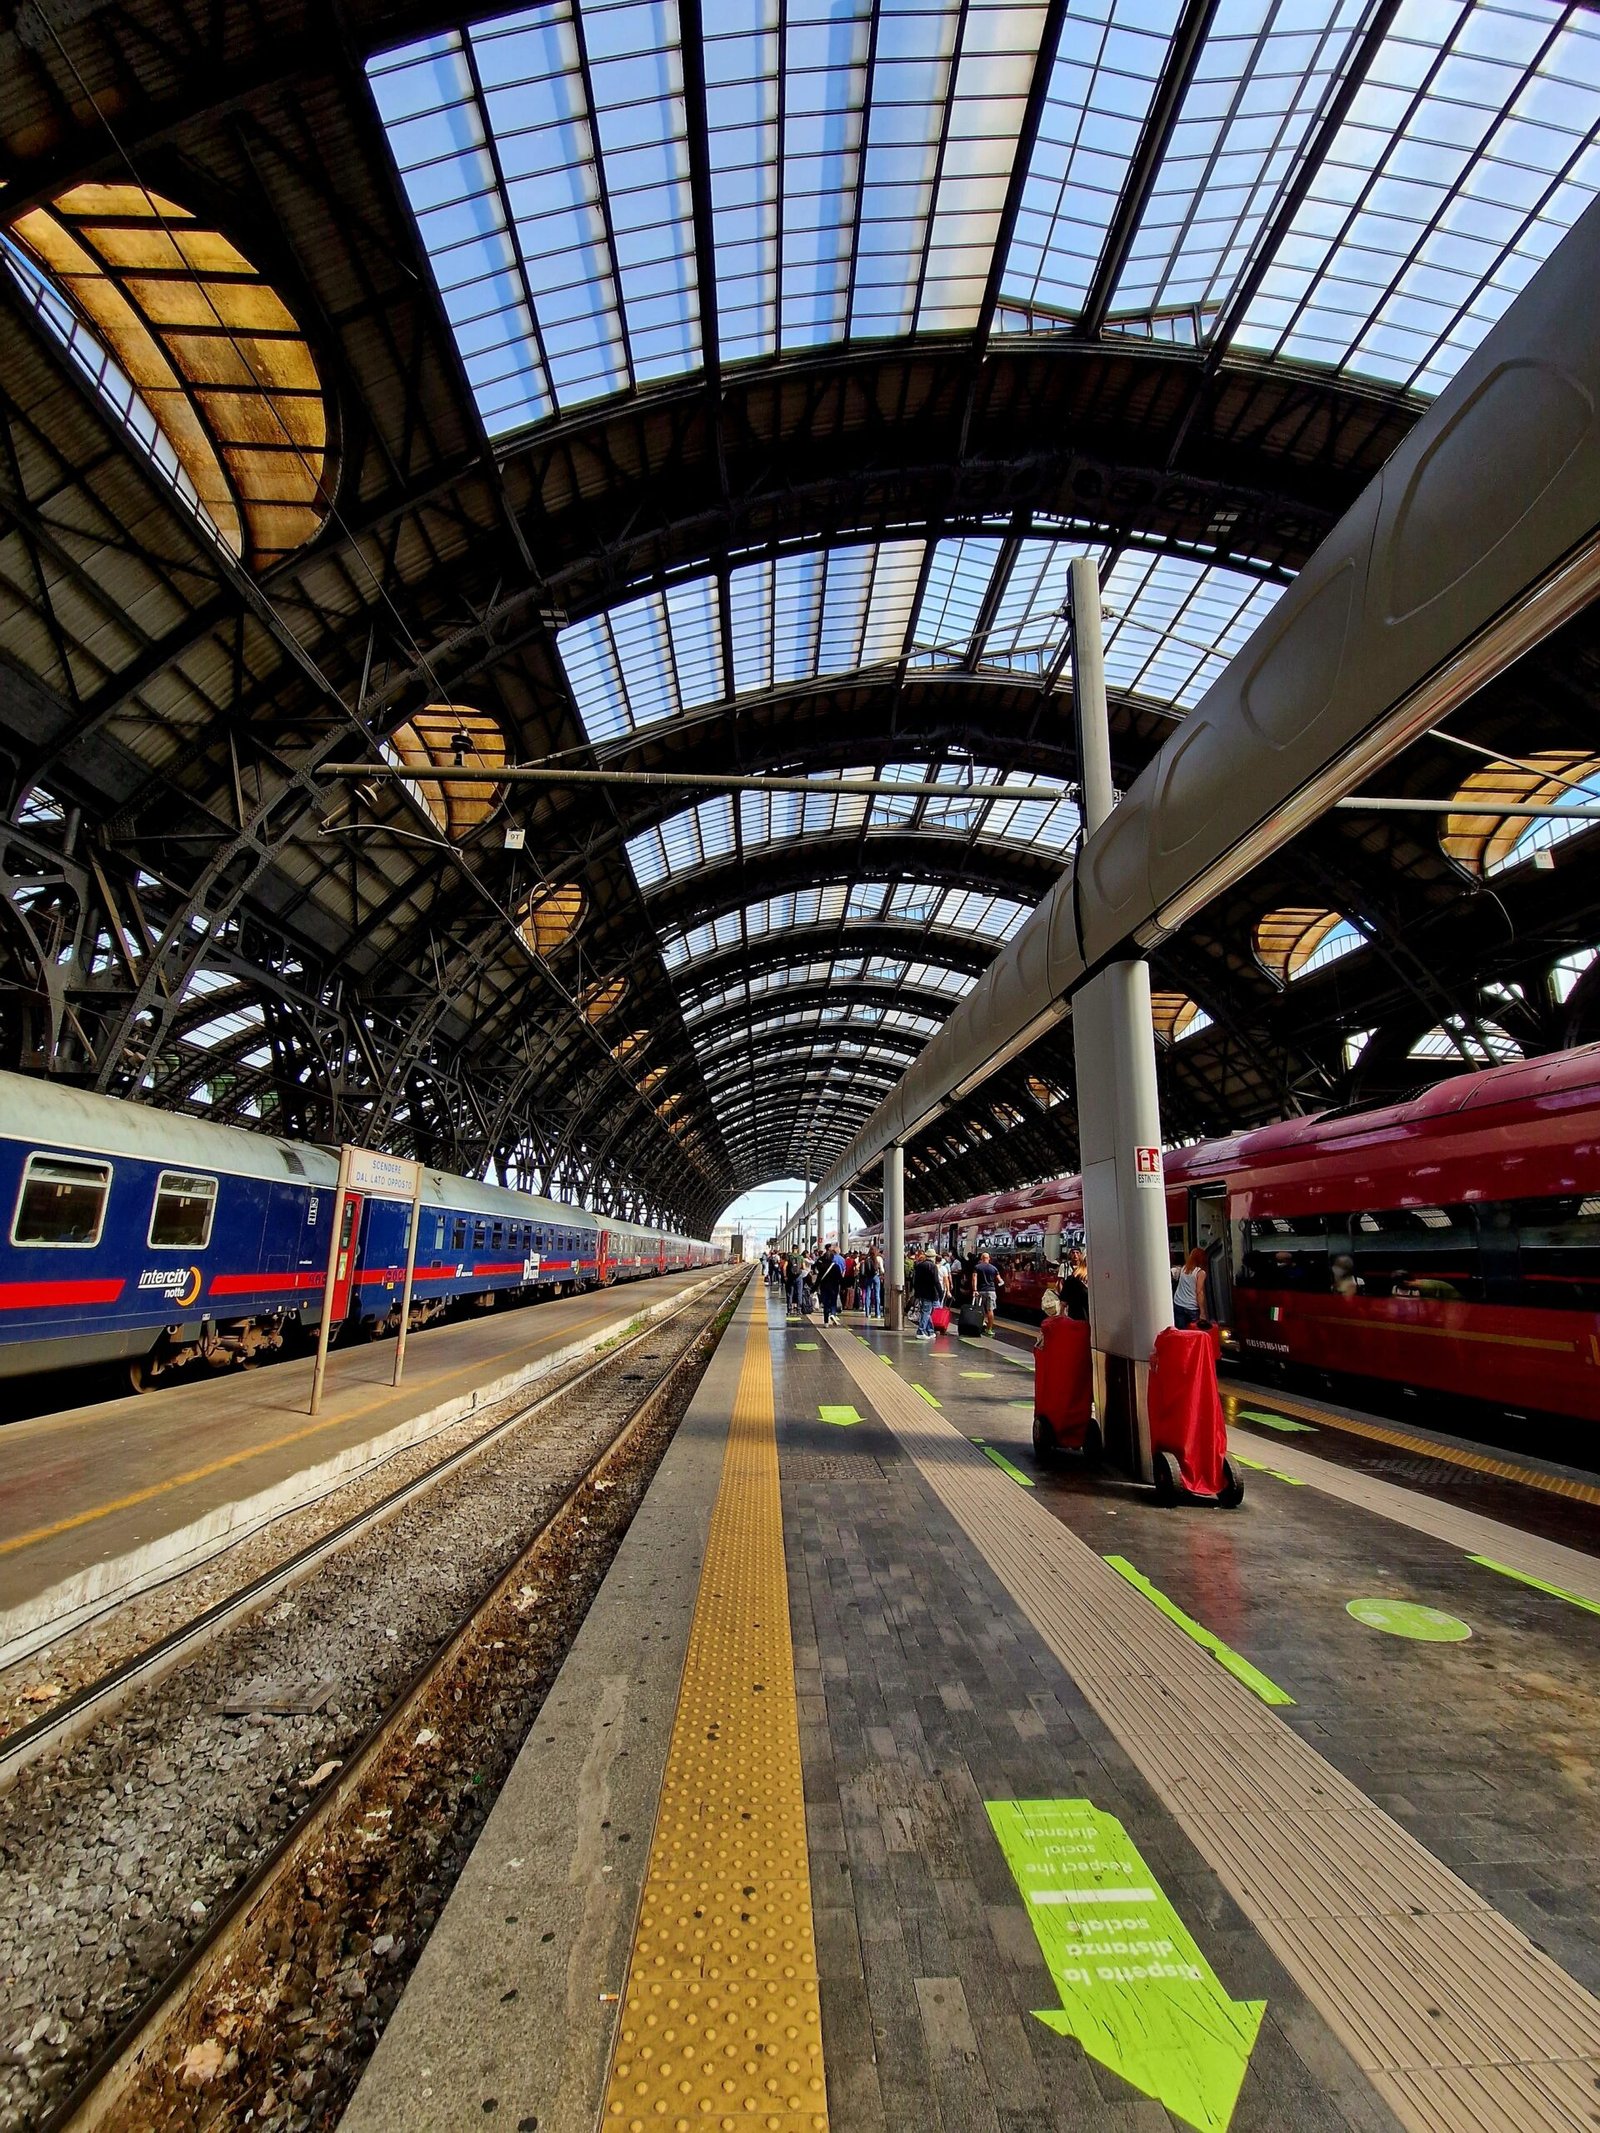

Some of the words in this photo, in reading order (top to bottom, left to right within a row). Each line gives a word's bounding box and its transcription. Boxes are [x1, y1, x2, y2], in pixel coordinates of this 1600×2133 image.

[372, 1160, 402, 1175] SCENDERE
[355, 1171, 368, 1183] DAL
[370, 1175, 386, 1186] LATO
[387, 1177, 413, 1190] OPPOSTO
[138, 1269, 191, 1287] intercity
[164, 1287, 185, 1298] notte
[1024, 1827, 1098, 1839] distance
[1044, 1844, 1096, 1857] social
[1024, 1861, 1056, 1876] the
[1062, 1859, 1133, 1875] Respect
[1066, 1918, 1149, 1936] sociale
[1066, 1940, 1173, 1957] distanza
[1063, 1967, 1092, 1986] la
[1096, 1961, 1204, 1983] Rispetta
